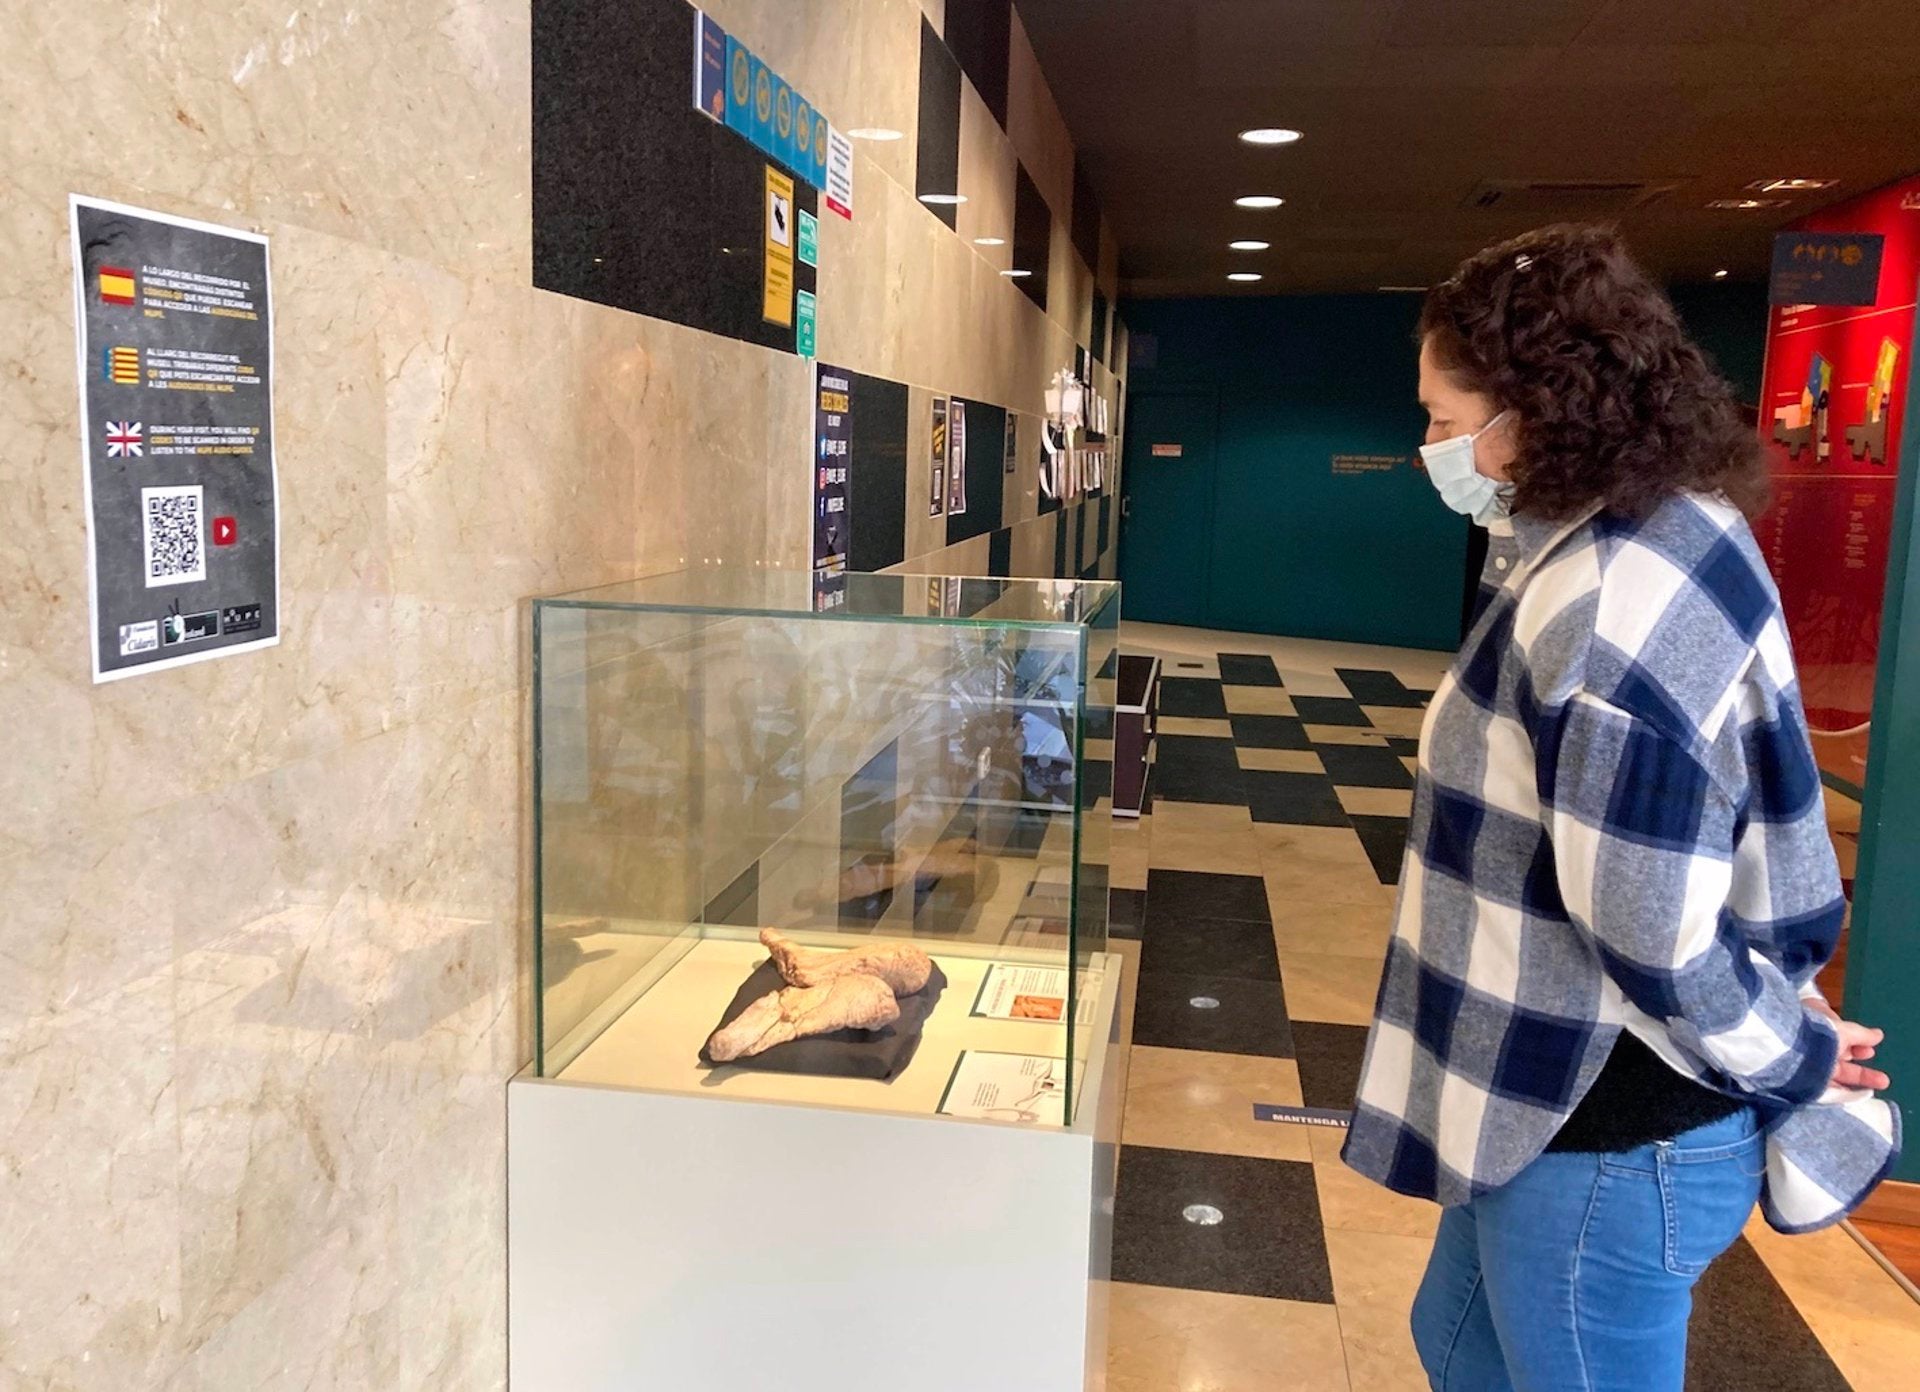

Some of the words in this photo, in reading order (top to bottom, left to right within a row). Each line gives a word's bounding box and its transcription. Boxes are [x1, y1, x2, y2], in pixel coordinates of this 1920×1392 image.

[144, 298, 162, 308] PARA
[177, 426, 193, 434] YOUR
[1272, 1113, 1339, 1127] MANTENGA
